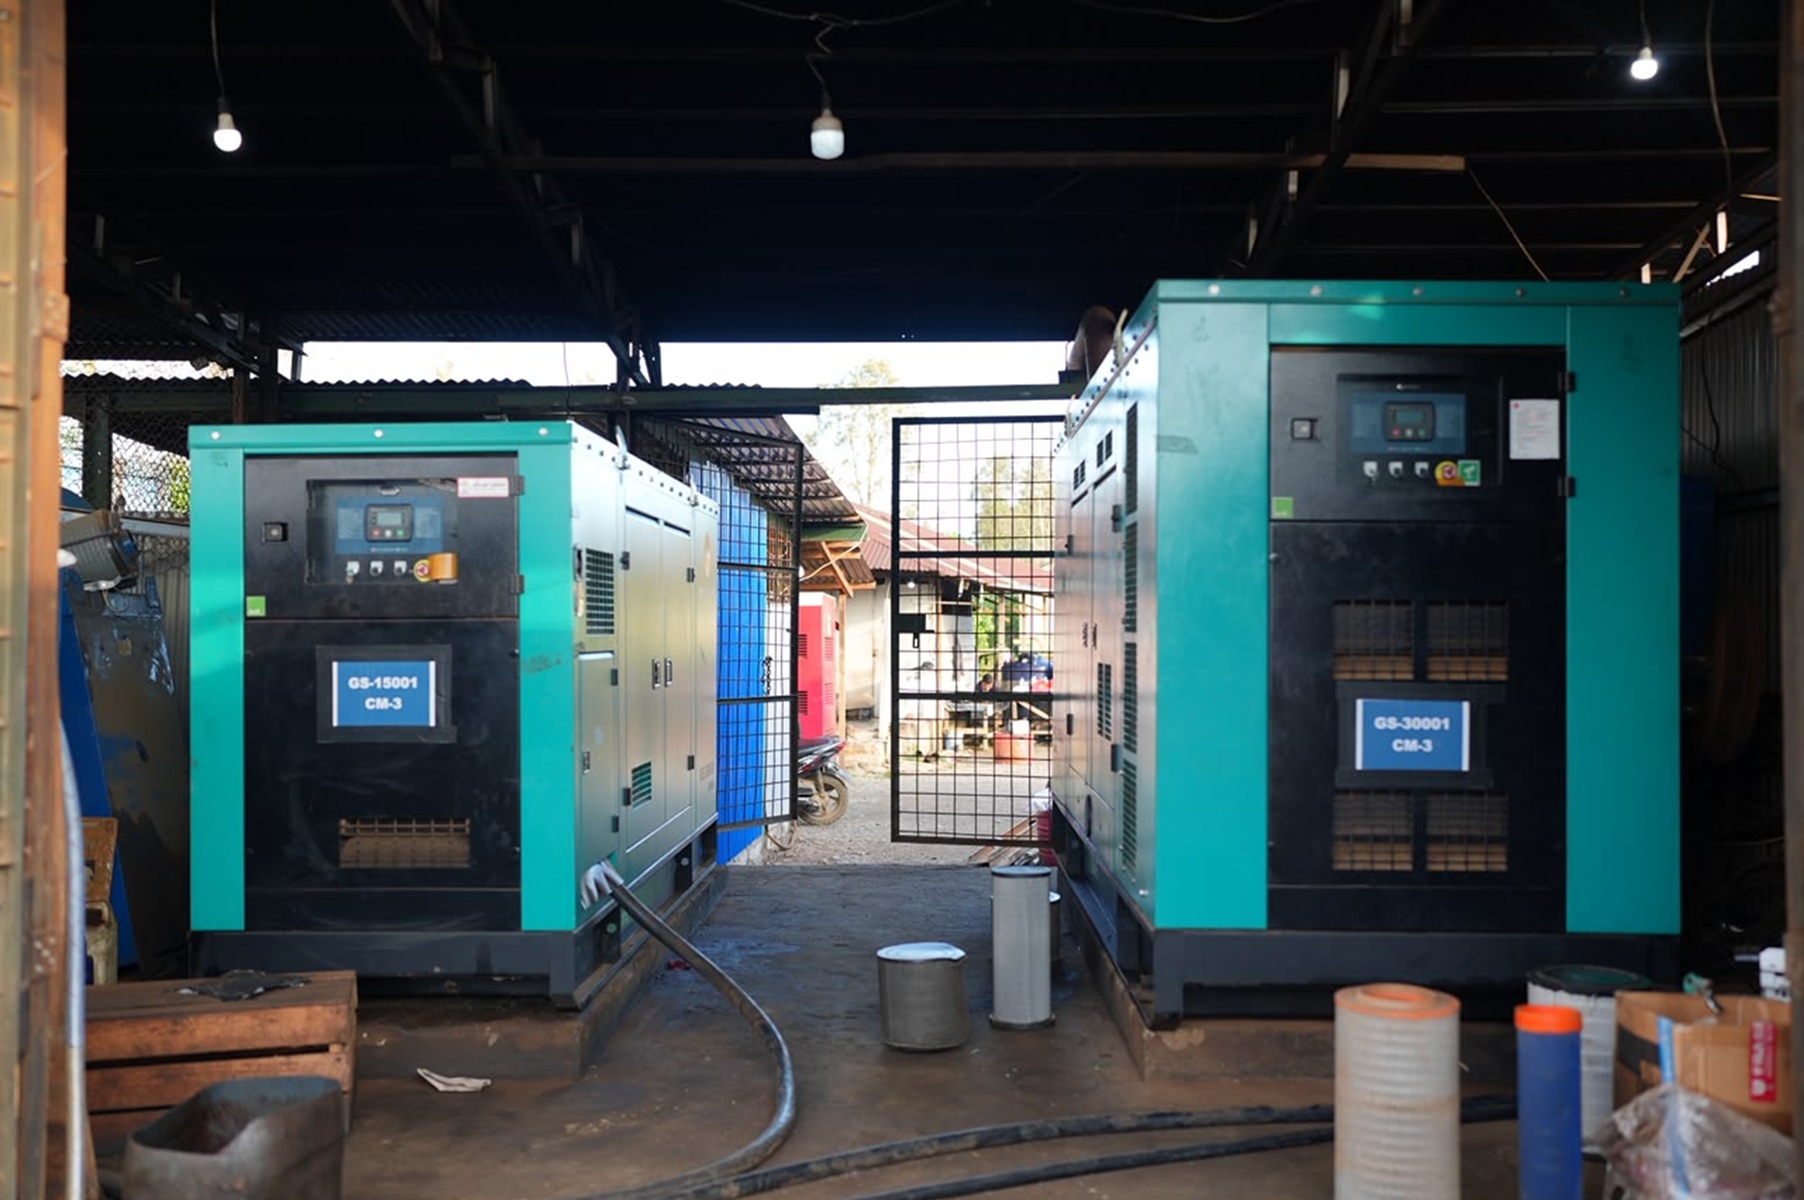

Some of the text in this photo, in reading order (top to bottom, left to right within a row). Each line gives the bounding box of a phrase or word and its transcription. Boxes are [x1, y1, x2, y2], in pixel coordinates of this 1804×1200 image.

[348, 676, 418, 690] GS-15001
[364, 697, 403, 710] CM-3
[1374, 716, 1450, 731] GS-30001
[1392, 738, 1433, 752] CM-3
